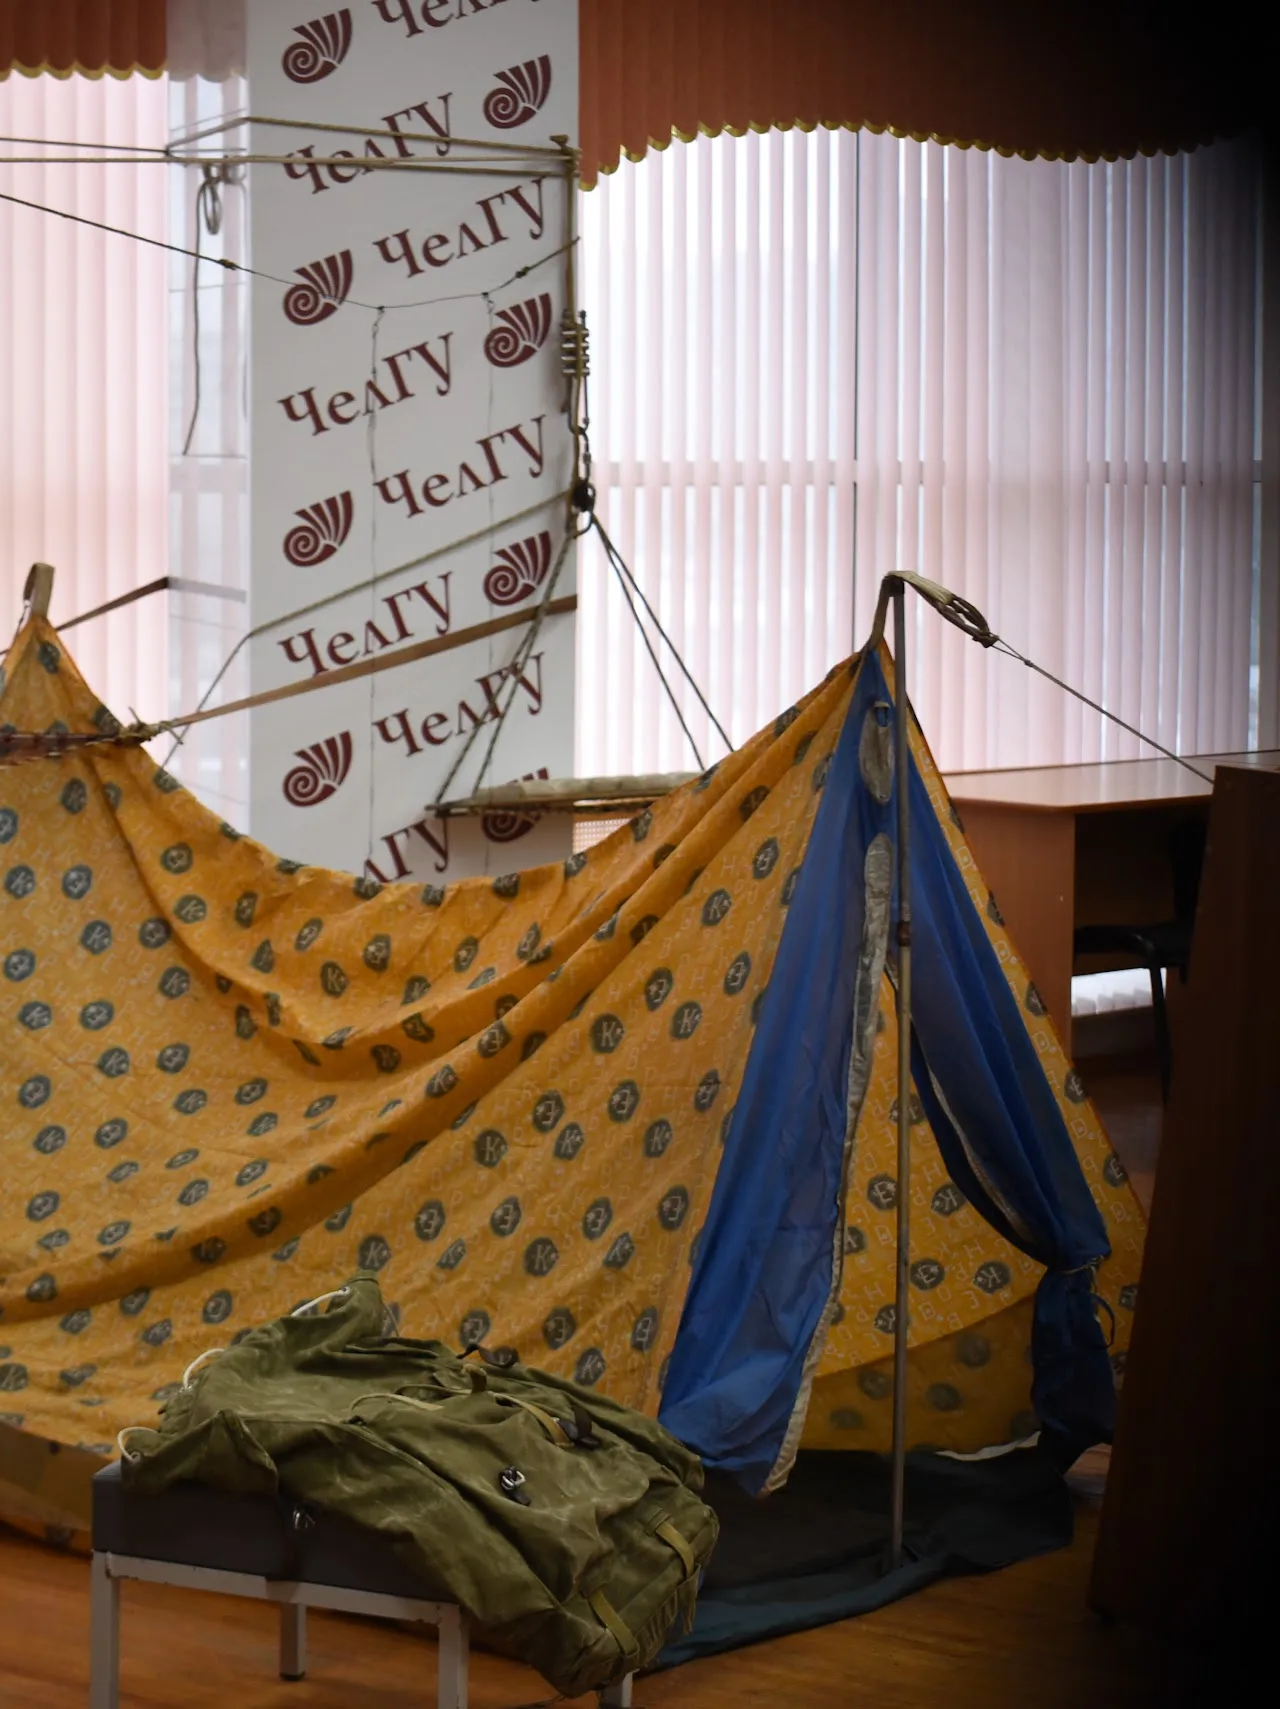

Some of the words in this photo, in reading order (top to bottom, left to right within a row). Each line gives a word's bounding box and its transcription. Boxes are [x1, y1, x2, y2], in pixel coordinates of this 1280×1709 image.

[372, 176, 546, 278] ЧелГУ
[277, 332, 454, 436] ЧелГУ
[373, 415, 547, 518] ЧелГУ
[277, 571, 453, 678] ЧелГУ
[371, 653, 545, 757] ЧелГУ
